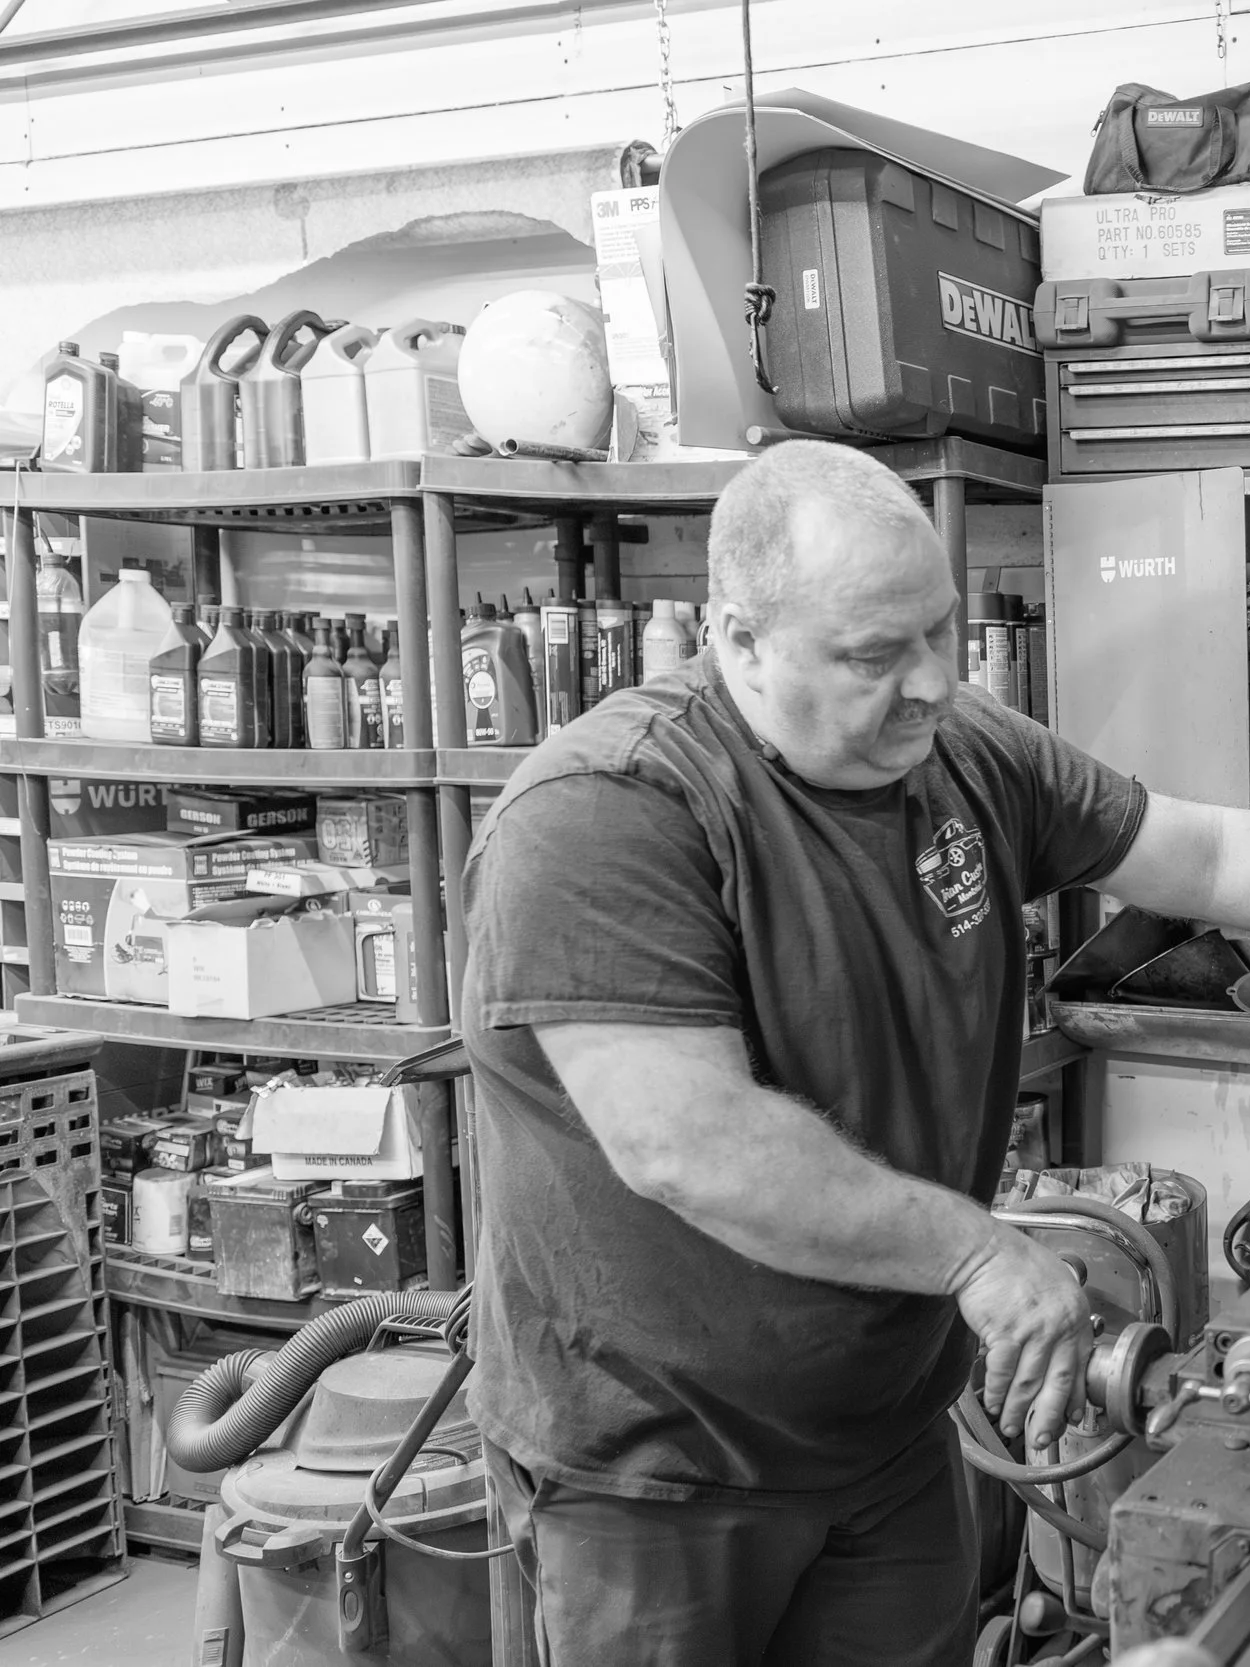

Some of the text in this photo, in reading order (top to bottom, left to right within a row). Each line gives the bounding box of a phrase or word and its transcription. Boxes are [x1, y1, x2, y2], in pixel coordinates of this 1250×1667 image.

[597, 201, 619, 218] 3M
[630, 197, 650, 211] PPS
[1096, 206, 1176, 224] ULTRA PRO
[1098, 227, 1130, 243] PART
[1143, 245, 1149, 259] 1
[1162, 241, 1196, 257] SETS
[939, 278, 1036, 351] DEWAL
[48, 400, 75, 409] ROTELLA
[1118, 556, 1176, 578] WÜRTH
[87, 783, 178, 809] WÜRT
[180, 808, 221, 825] GERSON
[246, 807, 308, 828] GERSON
[305, 1156, 374, 1167] MADE IN CANADA
